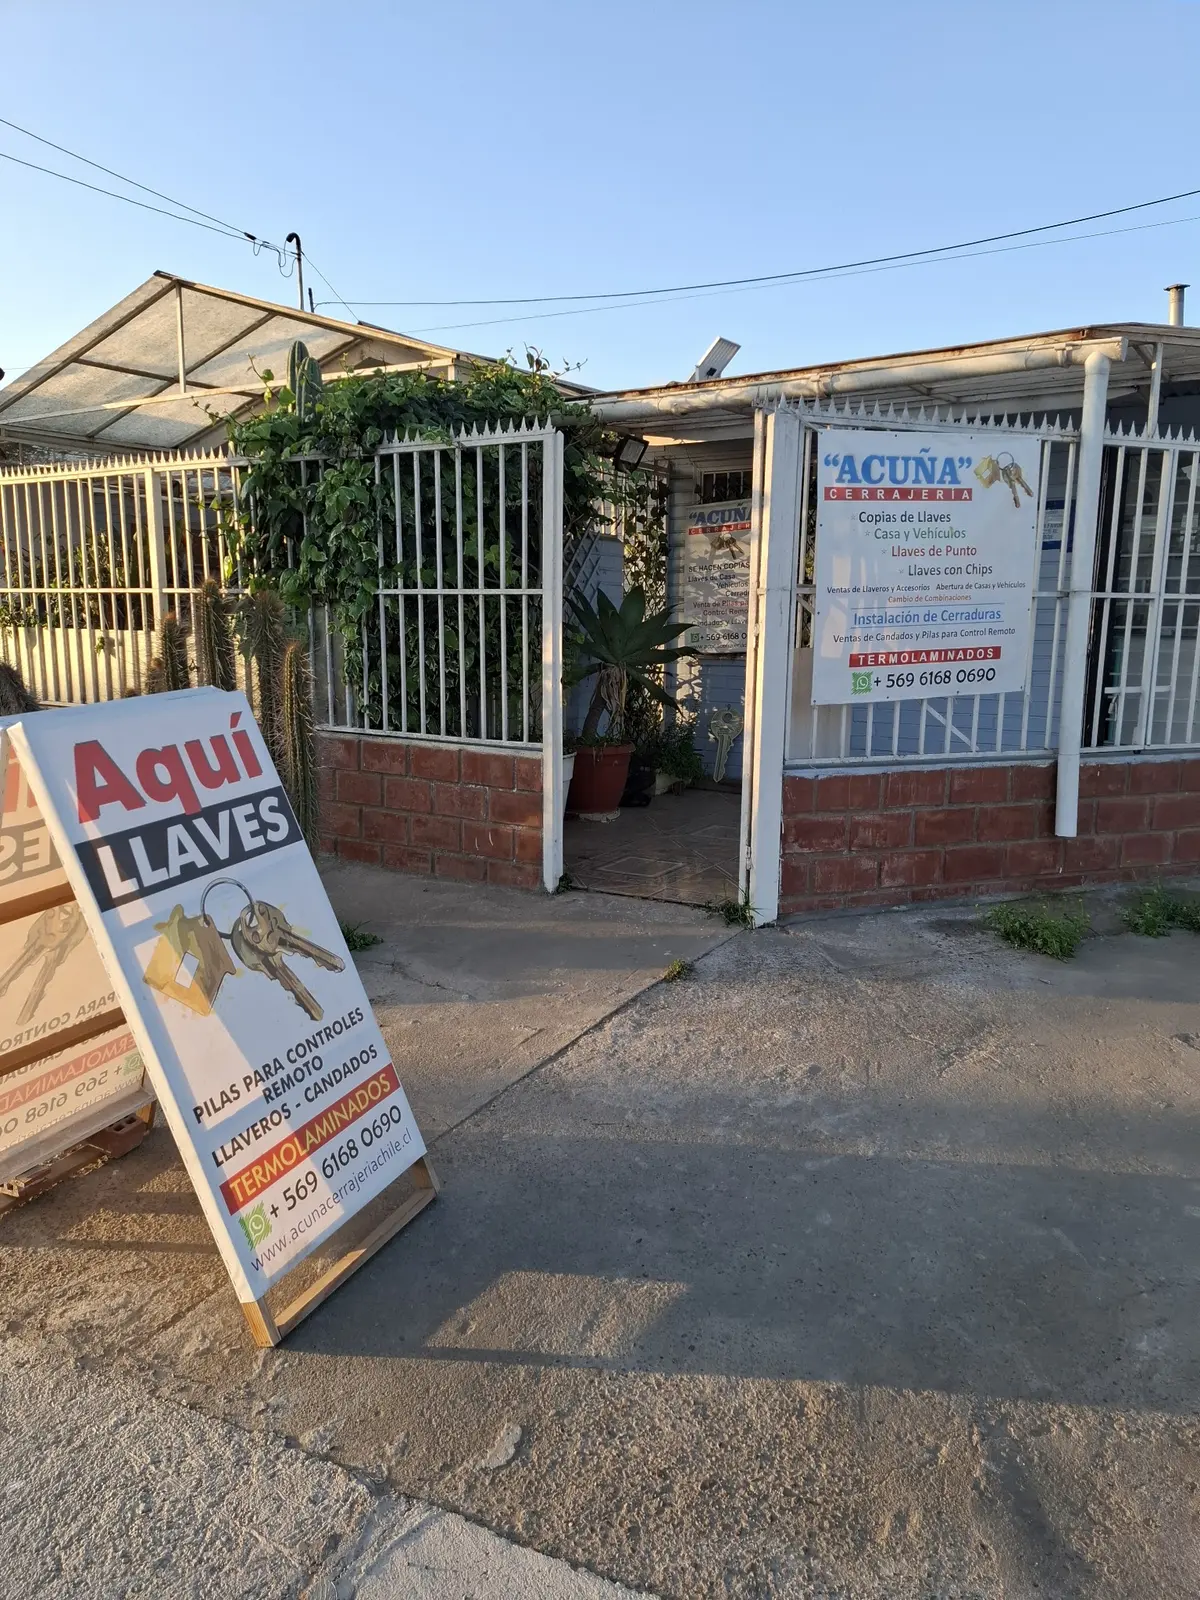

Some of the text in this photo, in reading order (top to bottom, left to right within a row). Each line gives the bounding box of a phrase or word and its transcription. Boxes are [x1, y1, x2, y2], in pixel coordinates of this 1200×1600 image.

[829, 488, 970, 500] CERRAJERÍA
[858, 511, 951, 525] Copias de Llaves
[874, 526, 967, 541] Casa y Vehículos
[891, 545, 977, 557] Llaves de Punto
[908, 563, 993, 577] Llaves con Chips
[862, 585, 890, 593] Llaveros
[896, 584, 931, 592] Accesorios
[936, 583, 964, 591] Abertura
[974, 582, 991, 590] Casas
[854, 608, 1002, 625] Instalación de Cerraduras
[833, 627, 1016, 643] Ventas de Candados y Pilas para Control Remoto
[858, 648, 994, 666] TERMOLAMINADOS
[886, 673, 915, 689] 569
[919, 670, 952, 686] 6168
[956, 667, 996, 684] 0690
[73, 711, 263, 824] Aquí
[96, 796, 290, 899] LLAVES
[192, 1083, 242, 1125] PILAS
[241, 1056, 286, 1092] PARA
[285, 1006, 365, 1065] CONTROLES
[262, 1054, 325, 1105] REMOTO
[211, 1101, 293, 1169] LLAVEROS
[303, 1043, 379, 1104] CANDADOS
[229, 1073, 392, 1205] TERMOLAMINADOS
[282, 1169, 320, 1213] 569
[321, 1139, 361, 1179] 6168
[360, 1104, 403, 1148] 0690
[250, 1127, 413, 1273] www.acunacerrajeriachile.cl
